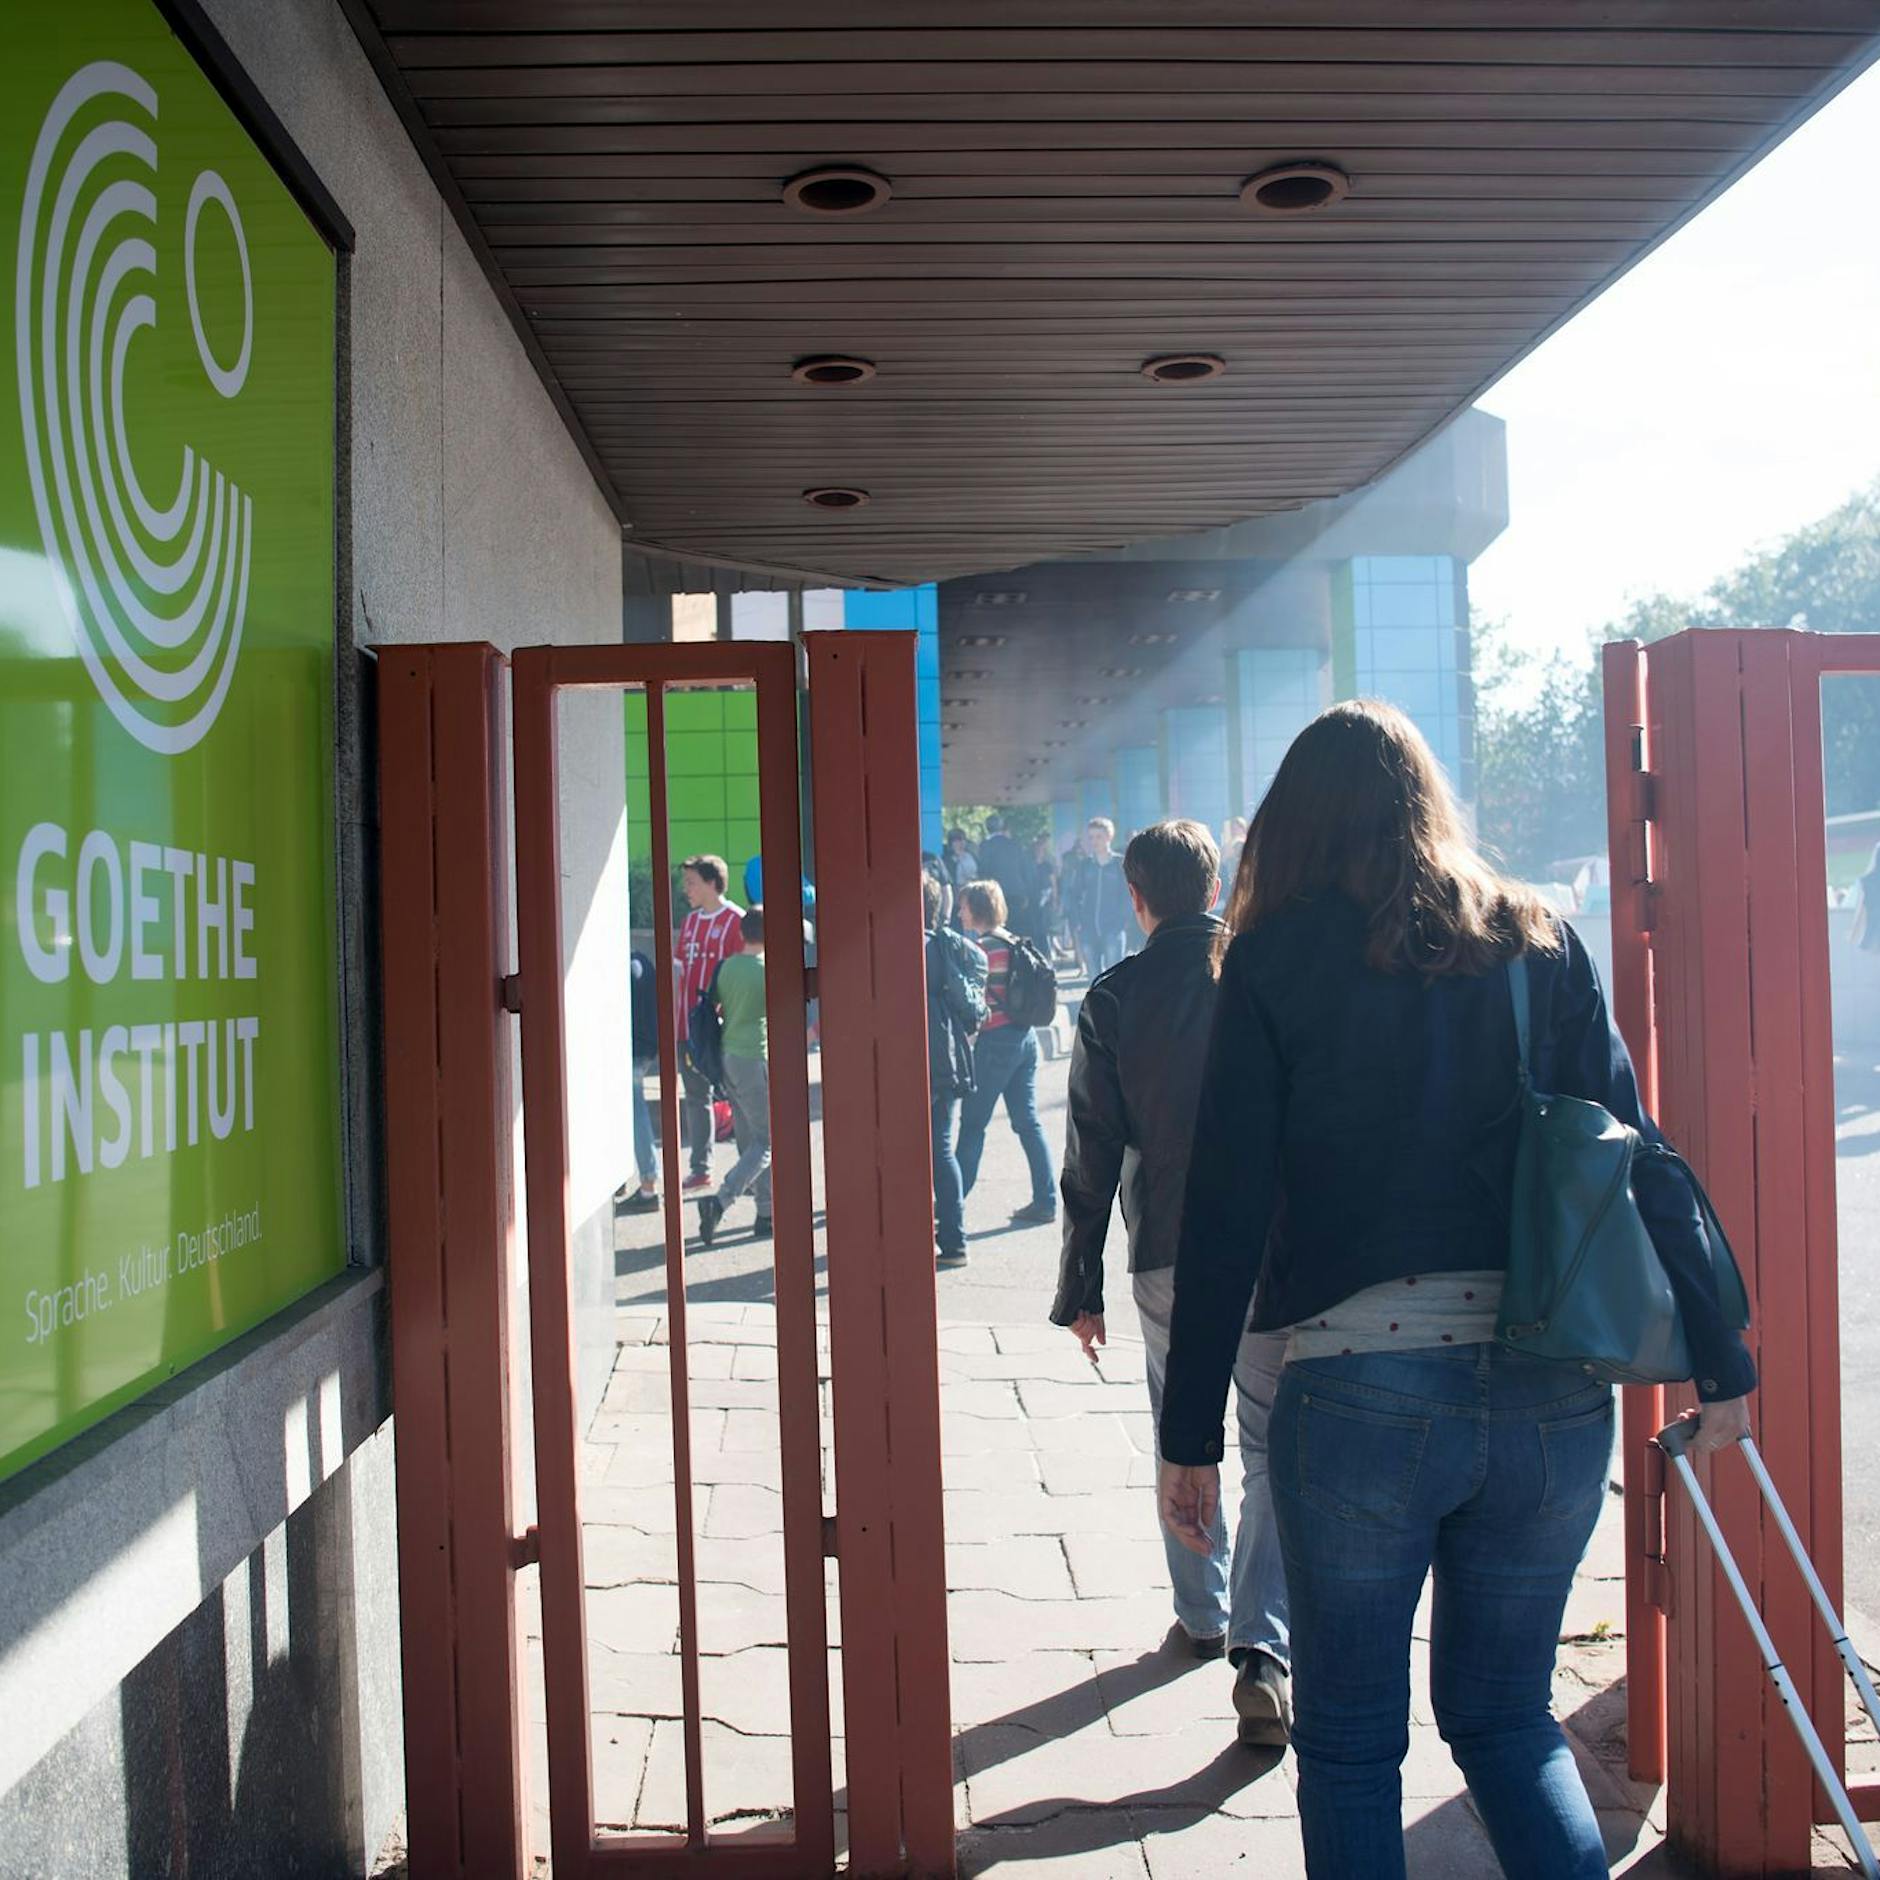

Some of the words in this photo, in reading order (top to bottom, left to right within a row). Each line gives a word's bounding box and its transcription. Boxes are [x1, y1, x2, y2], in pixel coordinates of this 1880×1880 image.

[16, 822, 257, 984] GOETHE
[22, 1017, 259, 1189] INSTITUT
[26, 1264, 113, 1345] Sprache.
[118, 1243, 173, 1300] Kultur.
[177, 1201, 263, 1275] Deutschland.
